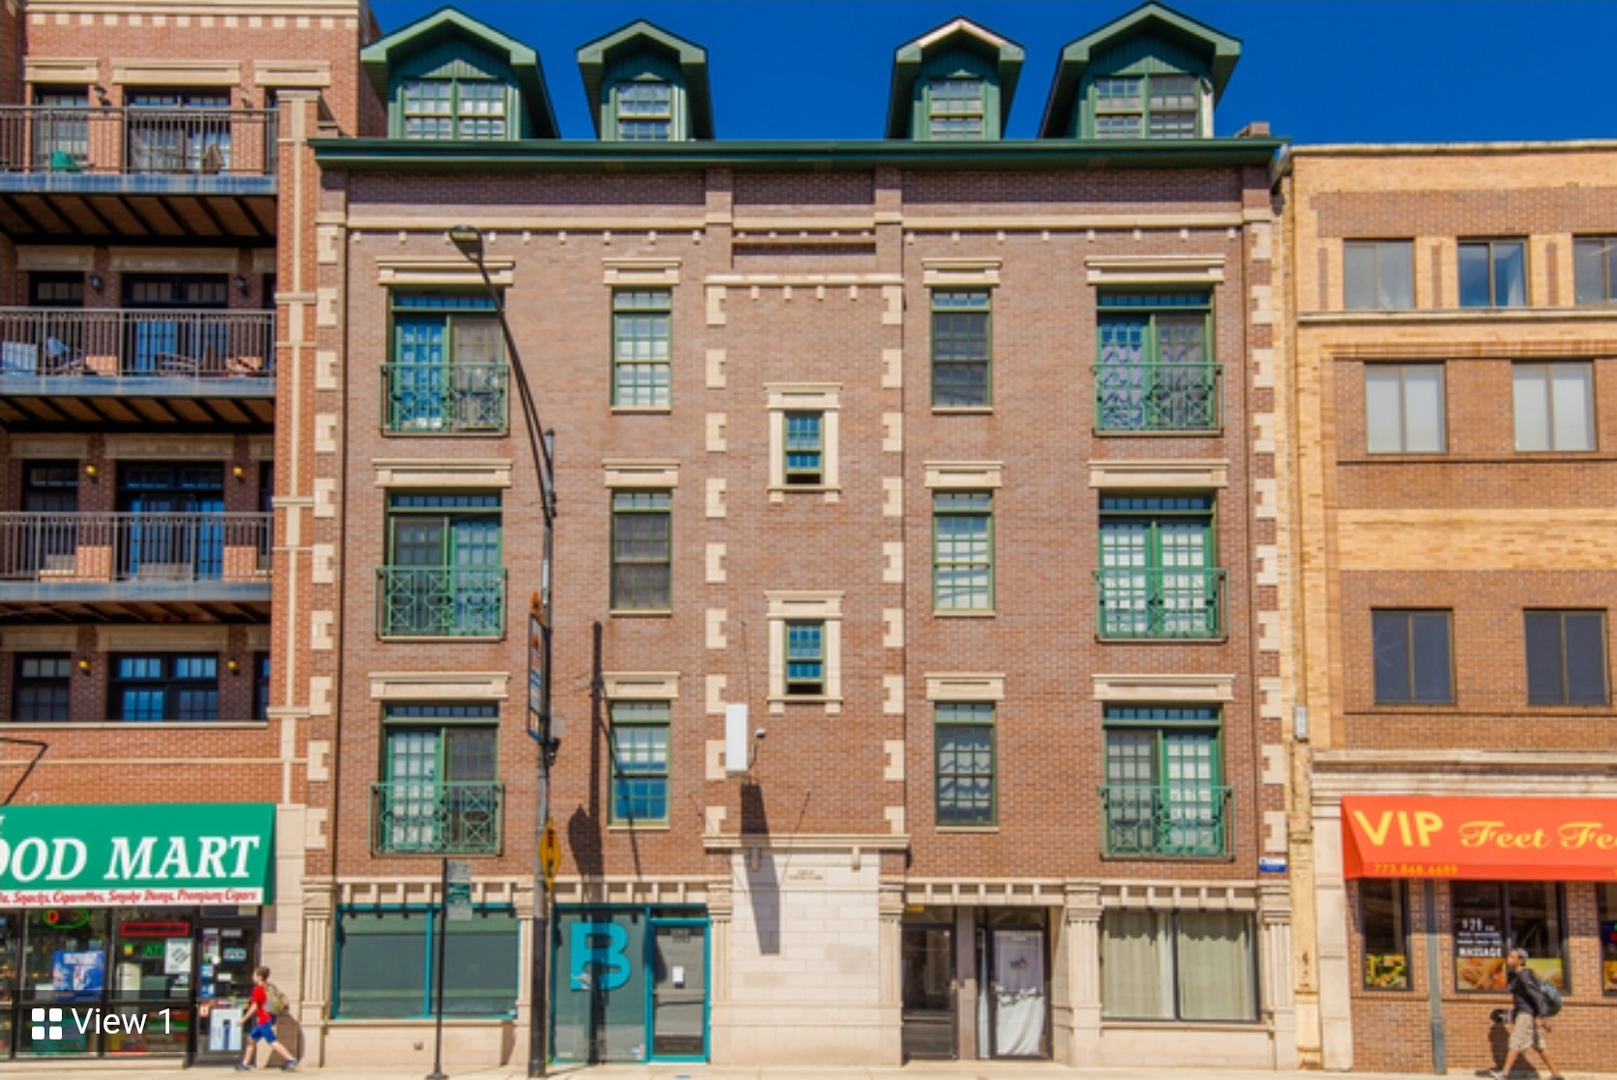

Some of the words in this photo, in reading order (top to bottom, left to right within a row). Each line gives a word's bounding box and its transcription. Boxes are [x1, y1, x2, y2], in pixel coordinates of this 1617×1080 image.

[1353, 811, 1443, 847] VIP
[1459, 821, 1551, 848] Feet
[1558, 822, 1617, 850] Fe
[104, 835, 260, 880] MART
[569, 921, 632, 991] B
